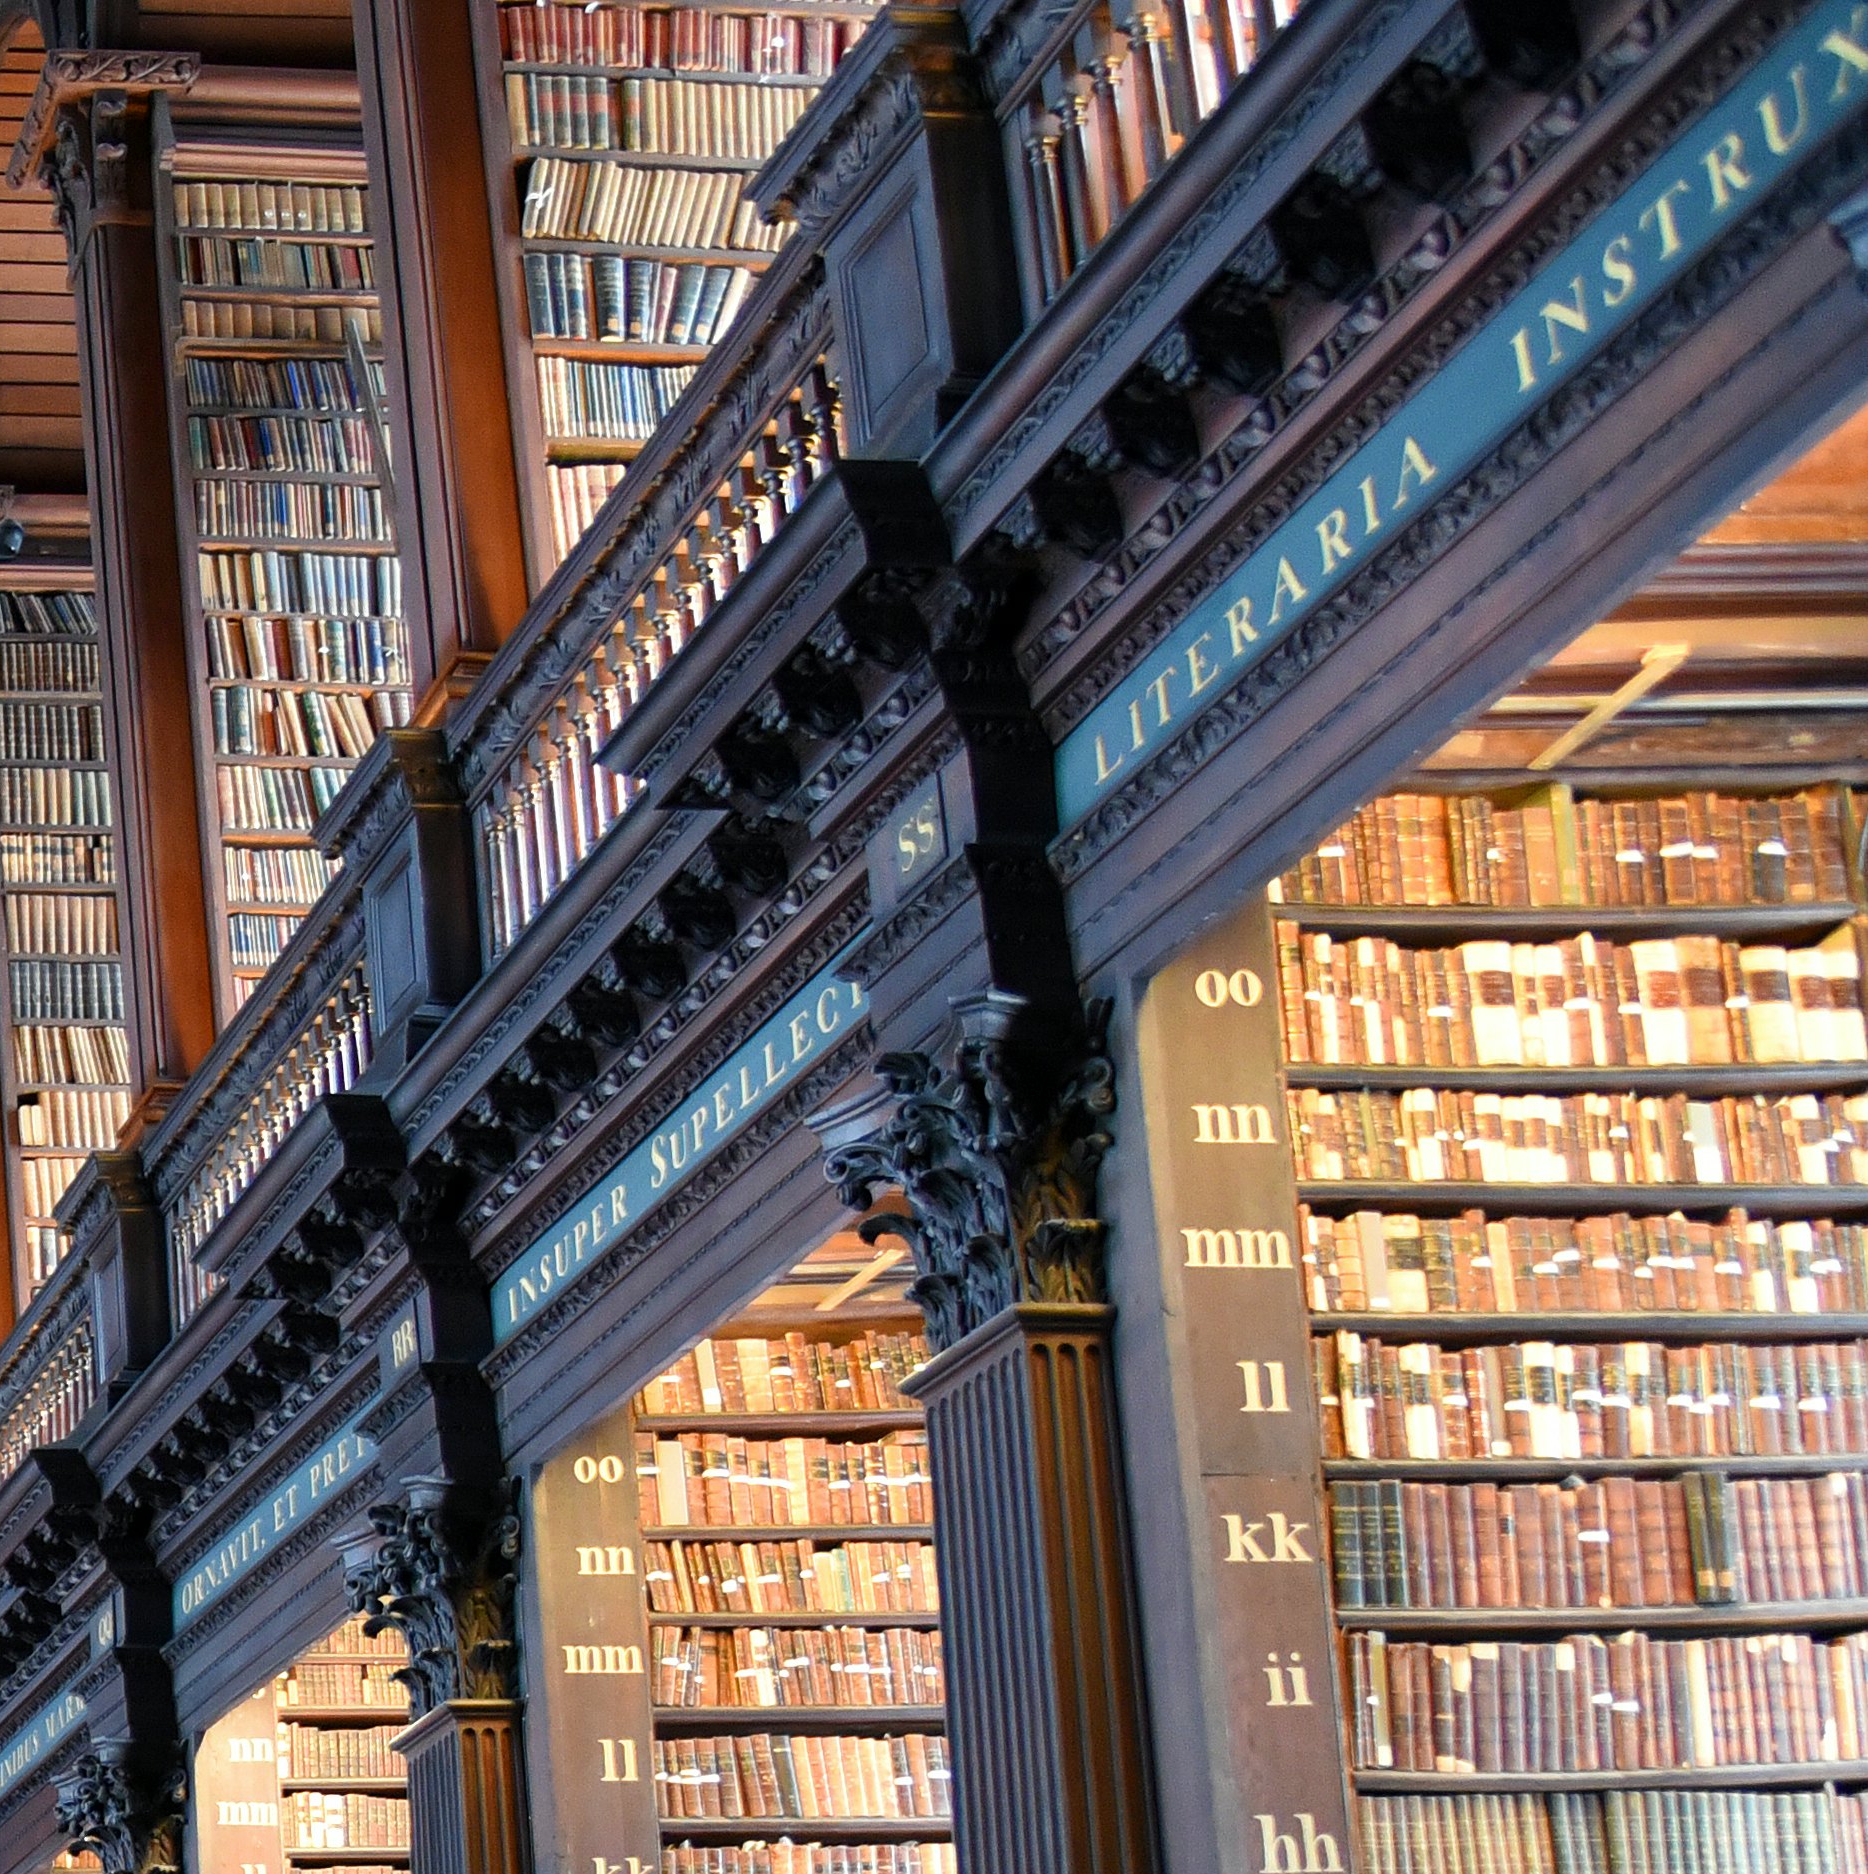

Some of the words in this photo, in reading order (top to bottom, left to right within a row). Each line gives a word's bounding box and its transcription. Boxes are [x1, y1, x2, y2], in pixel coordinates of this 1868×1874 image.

[1094, 435, 1437, 786] LITERARIA
[899, 798, 934, 873] SS
[1195, 970, 1262, 1007] oo
[1191, 1105, 1276, 1143] nn
[508, 1188, 629, 1322] INSUPER
[1181, 1229, 1293, 1268] mm
[1236, 1362, 1290, 1412] ll
[574, 1456, 623, 1483] oo
[181, 1524, 266, 1613] ORNAVIT,
[273, 1487, 299, 1532] ET
[1221, 1513, 1313, 1562] kk
[576, 1547, 635, 1574] nn
[562, 1646, 643, 1673] mm
[1263, 1653, 1312, 1705] ii
[229, 1739, 273, 1761] nn
[598, 1739, 638, 1781] ll
[217, 1802, 277, 1825] mm
[1254, 1814, 1344, 1874] hh
